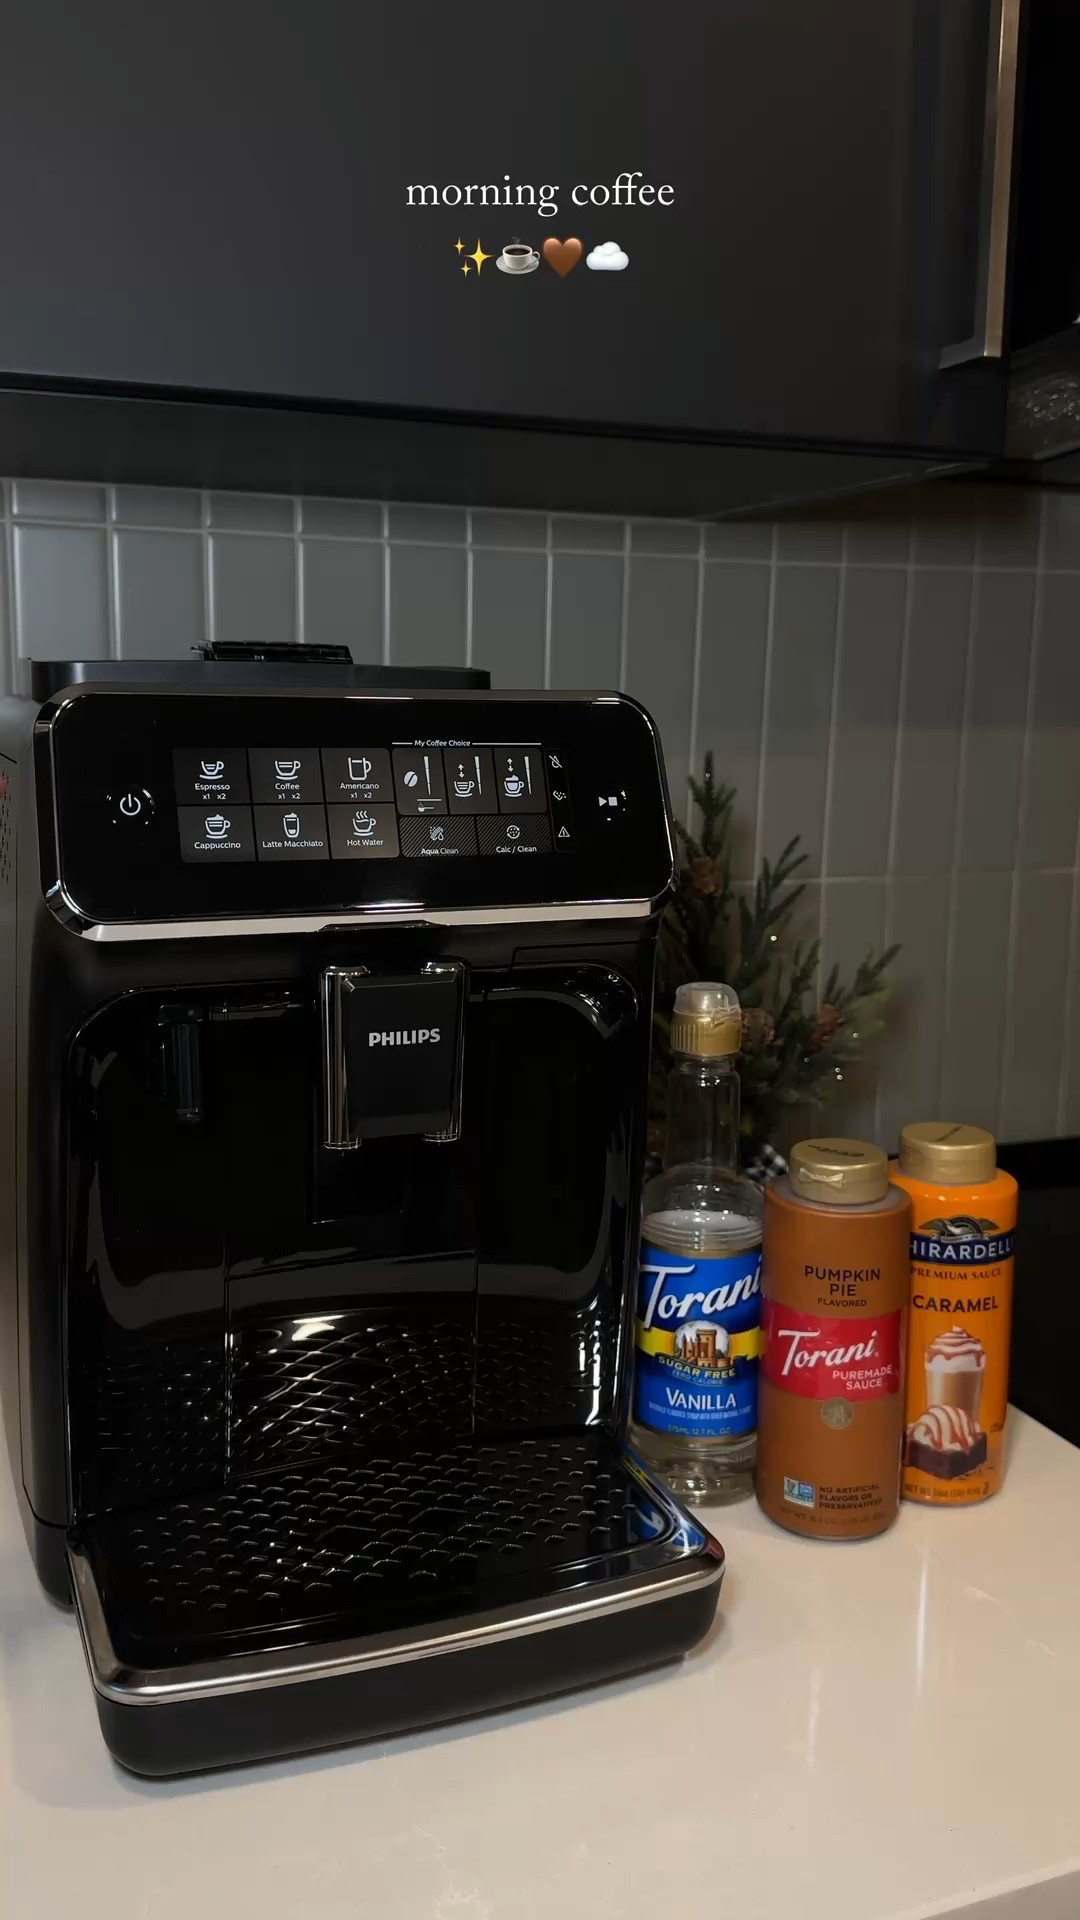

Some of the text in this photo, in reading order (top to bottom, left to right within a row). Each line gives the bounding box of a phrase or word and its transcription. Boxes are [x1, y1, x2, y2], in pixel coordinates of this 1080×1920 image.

[414, 739, 471, 748] My Coffee Choice
[194, 783, 231, 791] Espresso
[275, 782, 300, 790] Coffee
[339, 782, 380, 790] Americano
[194, 841, 241, 850] Cappuccino
[262, 840, 324, 848] Latte Macchiato
[347, 838, 384, 847] Hot Water
[496, 845, 511, 853] Calc
[420, 847, 439, 856] Aqua
[368, 1028, 441, 1047] PHILIPS
[804, 1265, 881, 1282] PUMPKIN
[910, 1266, 967, 1280] PREMIUM
[639, 1254, 762, 1329] Torani
[830, 1283, 857, 1297] PIE
[817, 1297, 867, 1308] FLAVORED
[912, 1295, 998, 1313] CARAMEL
[778, 1330, 878, 1376] Torani
[658, 1356, 736, 1379] SUGAR FREE
[832, 1364, 893, 1380] PUREMADE
[845, 1377, 883, 1391] SAUCE
[665, 1387, 737, 1410] VANILLA
